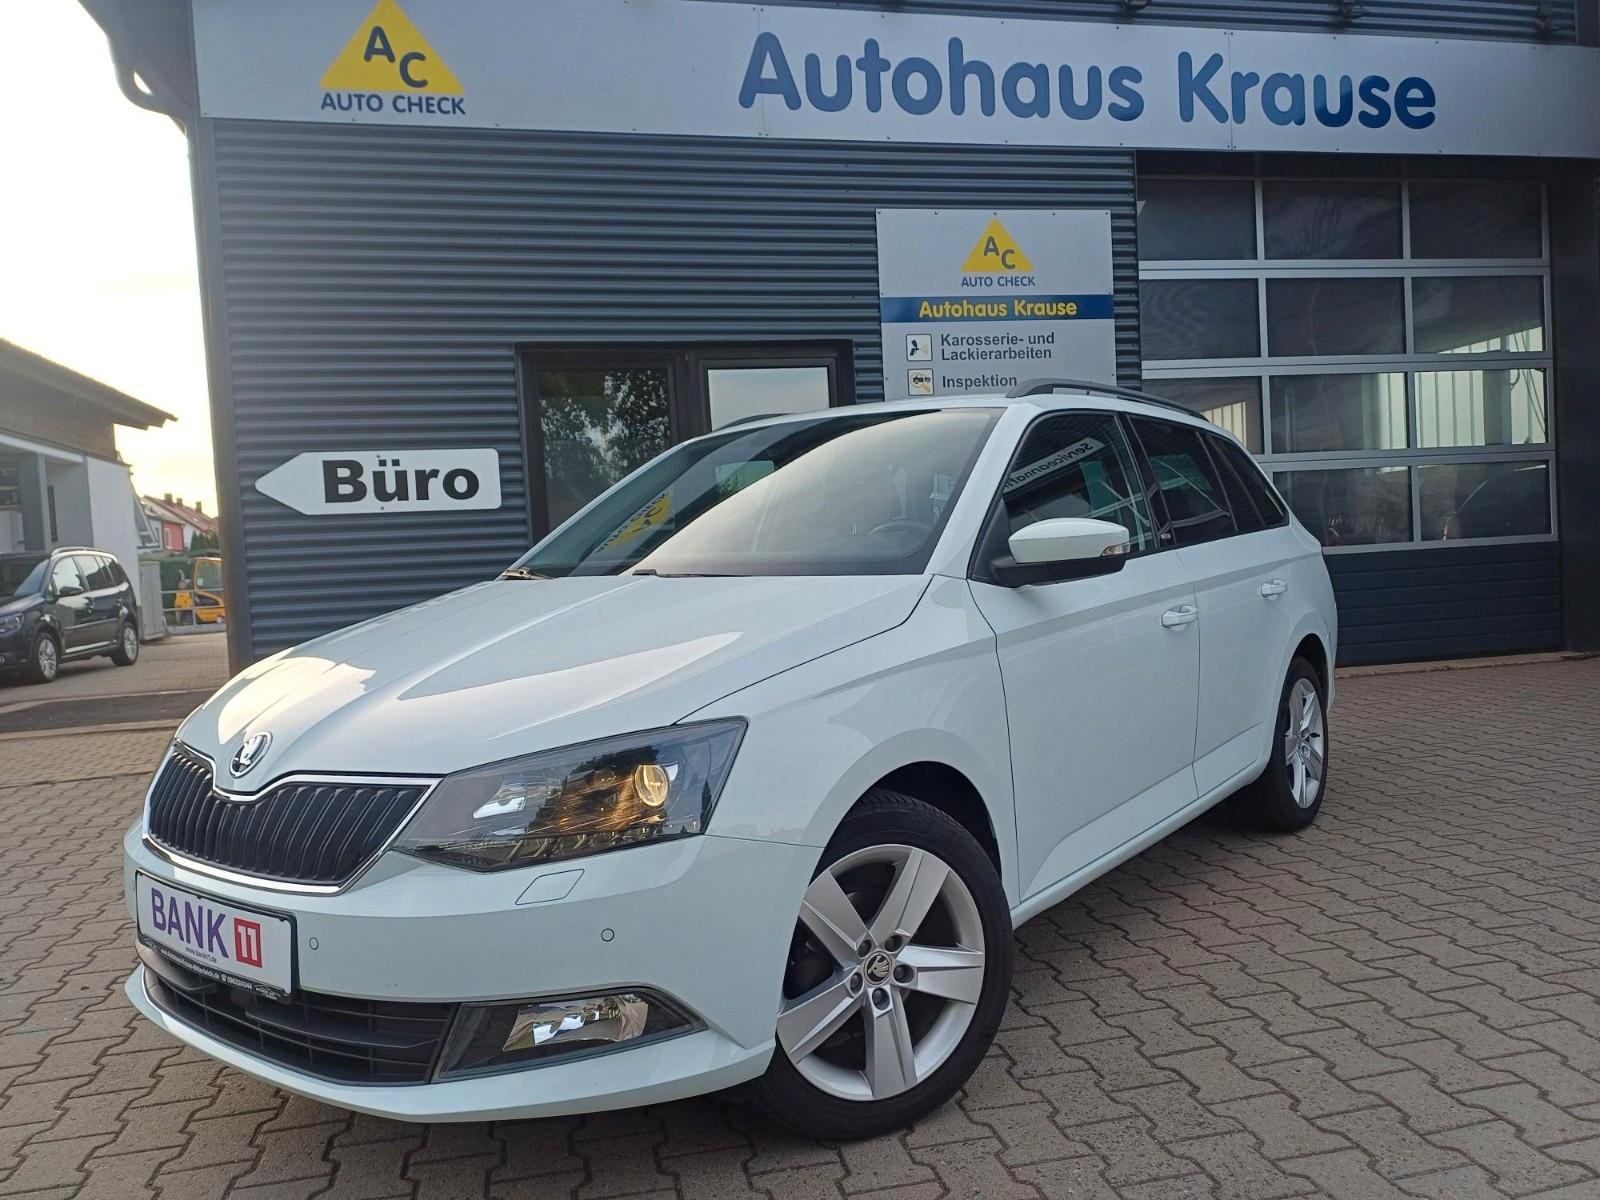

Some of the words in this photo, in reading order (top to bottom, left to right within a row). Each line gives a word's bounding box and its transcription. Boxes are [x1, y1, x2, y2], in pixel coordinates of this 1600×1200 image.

[738, 31, 1145, 122] Autohaus
[1177, 51, 1436, 130] Krause
[321, 92, 383, 112] AUTO
[392, 95, 466, 115] CHECK
[961, 277, 993, 288] AUTO
[997, 276, 1036, 287] CHECK
[919, 300, 1007, 318] Autohaus
[1014, 300, 1077, 316] Krause
[941, 333, 1024, 347] Karosserie-
[1028, 332, 1055, 345] und
[941, 347, 1052, 361] Lackierarbeiten
[942, 376, 1018, 390] Inspektion
[322, 459, 479, 504] Büro
[151, 887, 229, 959] BANK
[237, 924, 258, 963] 11
